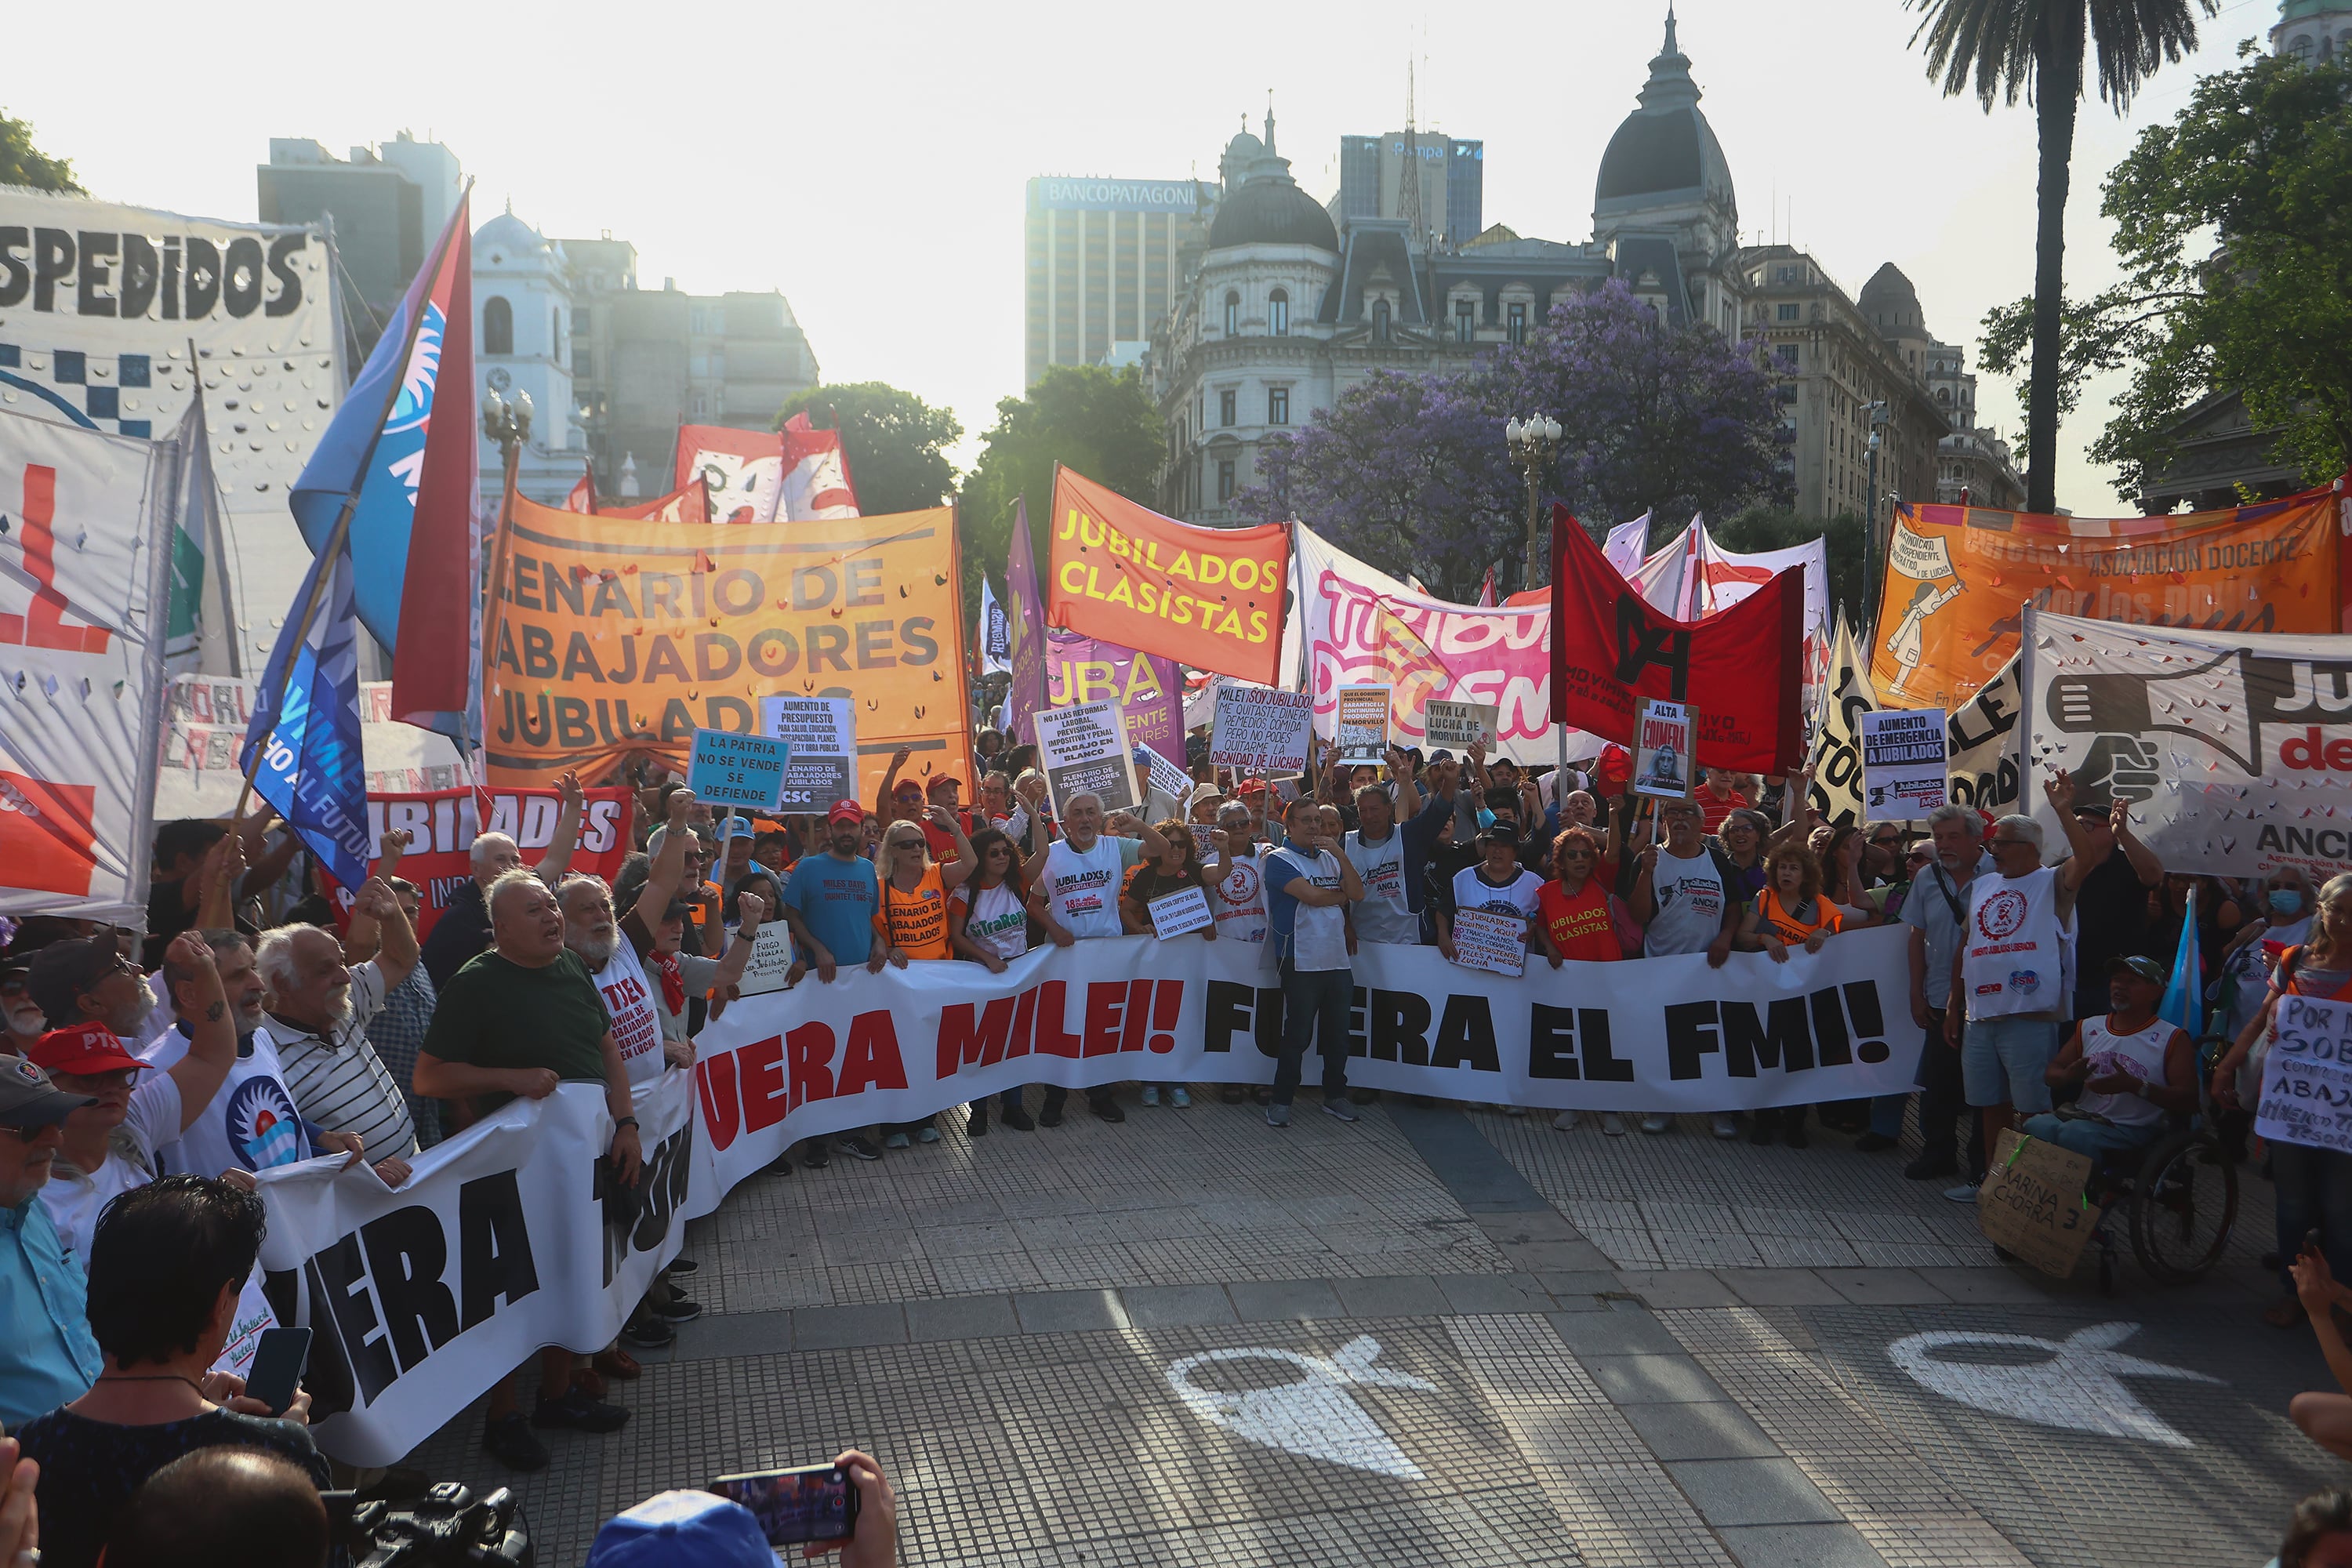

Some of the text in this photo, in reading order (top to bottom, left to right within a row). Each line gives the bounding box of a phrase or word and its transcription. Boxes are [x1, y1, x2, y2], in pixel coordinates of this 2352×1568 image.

[1050, 183, 1196, 205] BANCOPATAGONI
[1058, 510, 1278, 593] JUBILADOS
[2208, 536, 2297, 570] DOCENTE
[1929, 564, 1951, 579] LUCHA
[499, 553, 885, 619] ENARIO DE
[1060, 561, 1268, 644] CLASISTAS
[783, 701, 830, 712] AUMENTO DE
[1060, 711, 1072, 720] LAS
[1073, 704, 1108, 717] REFORMAS
[1218, 702, 1233, 714] ME
[1430, 704, 1467, 718] VIVA LA
[1654, 704, 1678, 719] ALTA
[498, 687, 853, 747] JUBILAD
[782, 713, 833, 724] PRESUPUESTO
[1429, 717, 1479, 731] LUCHA DE
[1878, 716, 1926, 732] AUMENTO
[1048, 728, 1113, 747] IMPOSITIVA Y PENAL
[1225, 728, 1292, 743] PERO NO PODES
[1430, 730, 1473, 742] MORVILLO
[1866, 728, 1942, 747] DE EMERGENCIA
[710, 737, 775, 755] LA PATRIA
[806, 744, 818, 753] OBRA
[1051, 742, 1098, 755] TRABAJO
[1273, 744, 1285, 755] LA
[1868, 743, 1943, 764] A JUBILADOS
[697, 753, 781, 771] NO SE VENDE
[1064, 749, 1105, 761] BLANCO
[1254, 754, 1304, 770] DE LUCHAR
[727, 772, 745, 783] SE
[1059, 771, 1120, 789] TRABAJADORES
[1062, 769, 1102, 782] PLENARIO
[704, 785, 767, 800] DEFIENDE
[1070, 780, 1112, 793] JUBILADOS
[1898, 781, 1942, 791] Jubiladxs
[782, 790, 811, 803] CSC
[1909, 789, 1943, 799] izquierda
[1920, 797, 1944, 808] MST
[823, 879, 866, 889] MILES DAVIS
[1055, 869, 1104, 888] JUBILADXS
[1377, 881, 1400, 891] ANCLA
[1057, 880, 1104, 896] ANTICAPITALISTAS
[931, 900, 942, 912] DE
[1065, 899, 1076, 909] 18
[1692, 897, 1719, 909] ANCLA
[1456, 919, 1490, 931] SEGUIMOS
[1555, 921, 1609, 942] CLASISTAS
[761, 930, 775, 939] DEL
[1465, 928, 1514, 946] TRAICIONAMOS
[757, 941, 779, 952] FUEGO
[1453, 940, 1521, 961] SOMOS RESISTENTES
[1463, 935, 1483, 944] SOMOS
[1485, 940, 1518, 953] COBARDES
[1458, 948, 1485, 959] FIELES
[1494, 957, 1523, 968] NUESTRA
[1461, 956, 1488, 967] LUCHA
[2013, 975, 2036, 985] FSM
[612, 1004, 645, 1029] UNION DE
[2288, 998, 2333, 1030] POR
[83, 1032, 119, 1050] PTS
[620, 1037, 655, 1061] EN LUCHA
[696, 1009, 909, 1152] UERA
[936, 978, 1184, 1080] MILEI!!
[1529, 1003, 1635, 1081] EL
[1994, 1185, 2055, 1230] CHORRA
